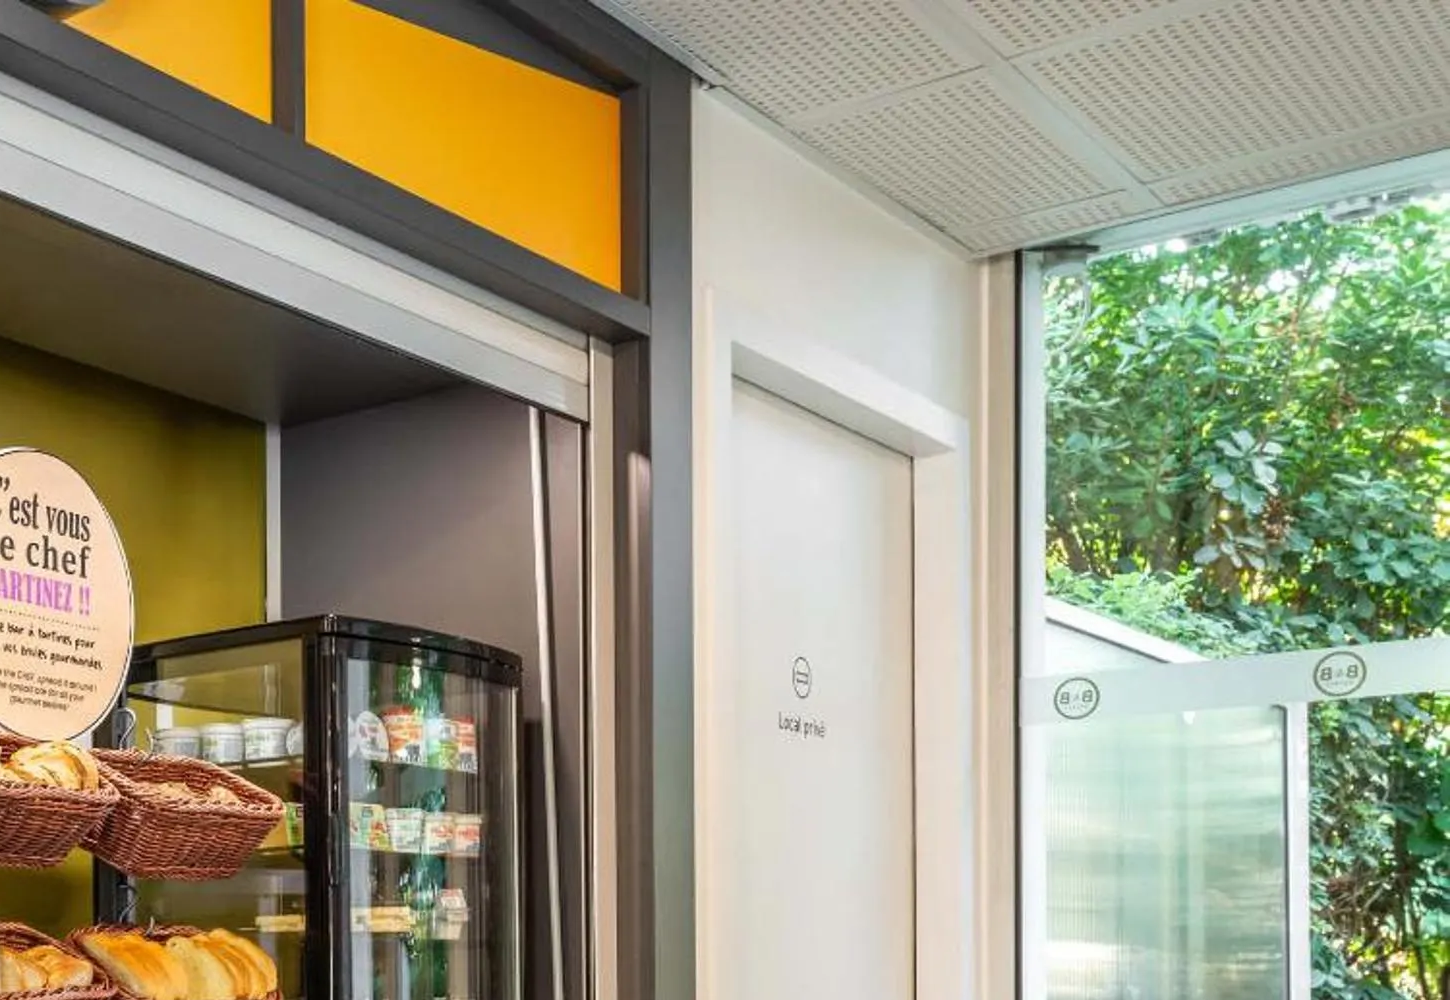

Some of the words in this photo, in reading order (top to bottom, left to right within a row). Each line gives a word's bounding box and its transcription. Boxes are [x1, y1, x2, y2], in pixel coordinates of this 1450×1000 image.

[46, 506, 91, 542] vous
[26, 535, 91, 579] chef
[75, 638, 96, 651] pour
[778, 711, 801, 732] Local
